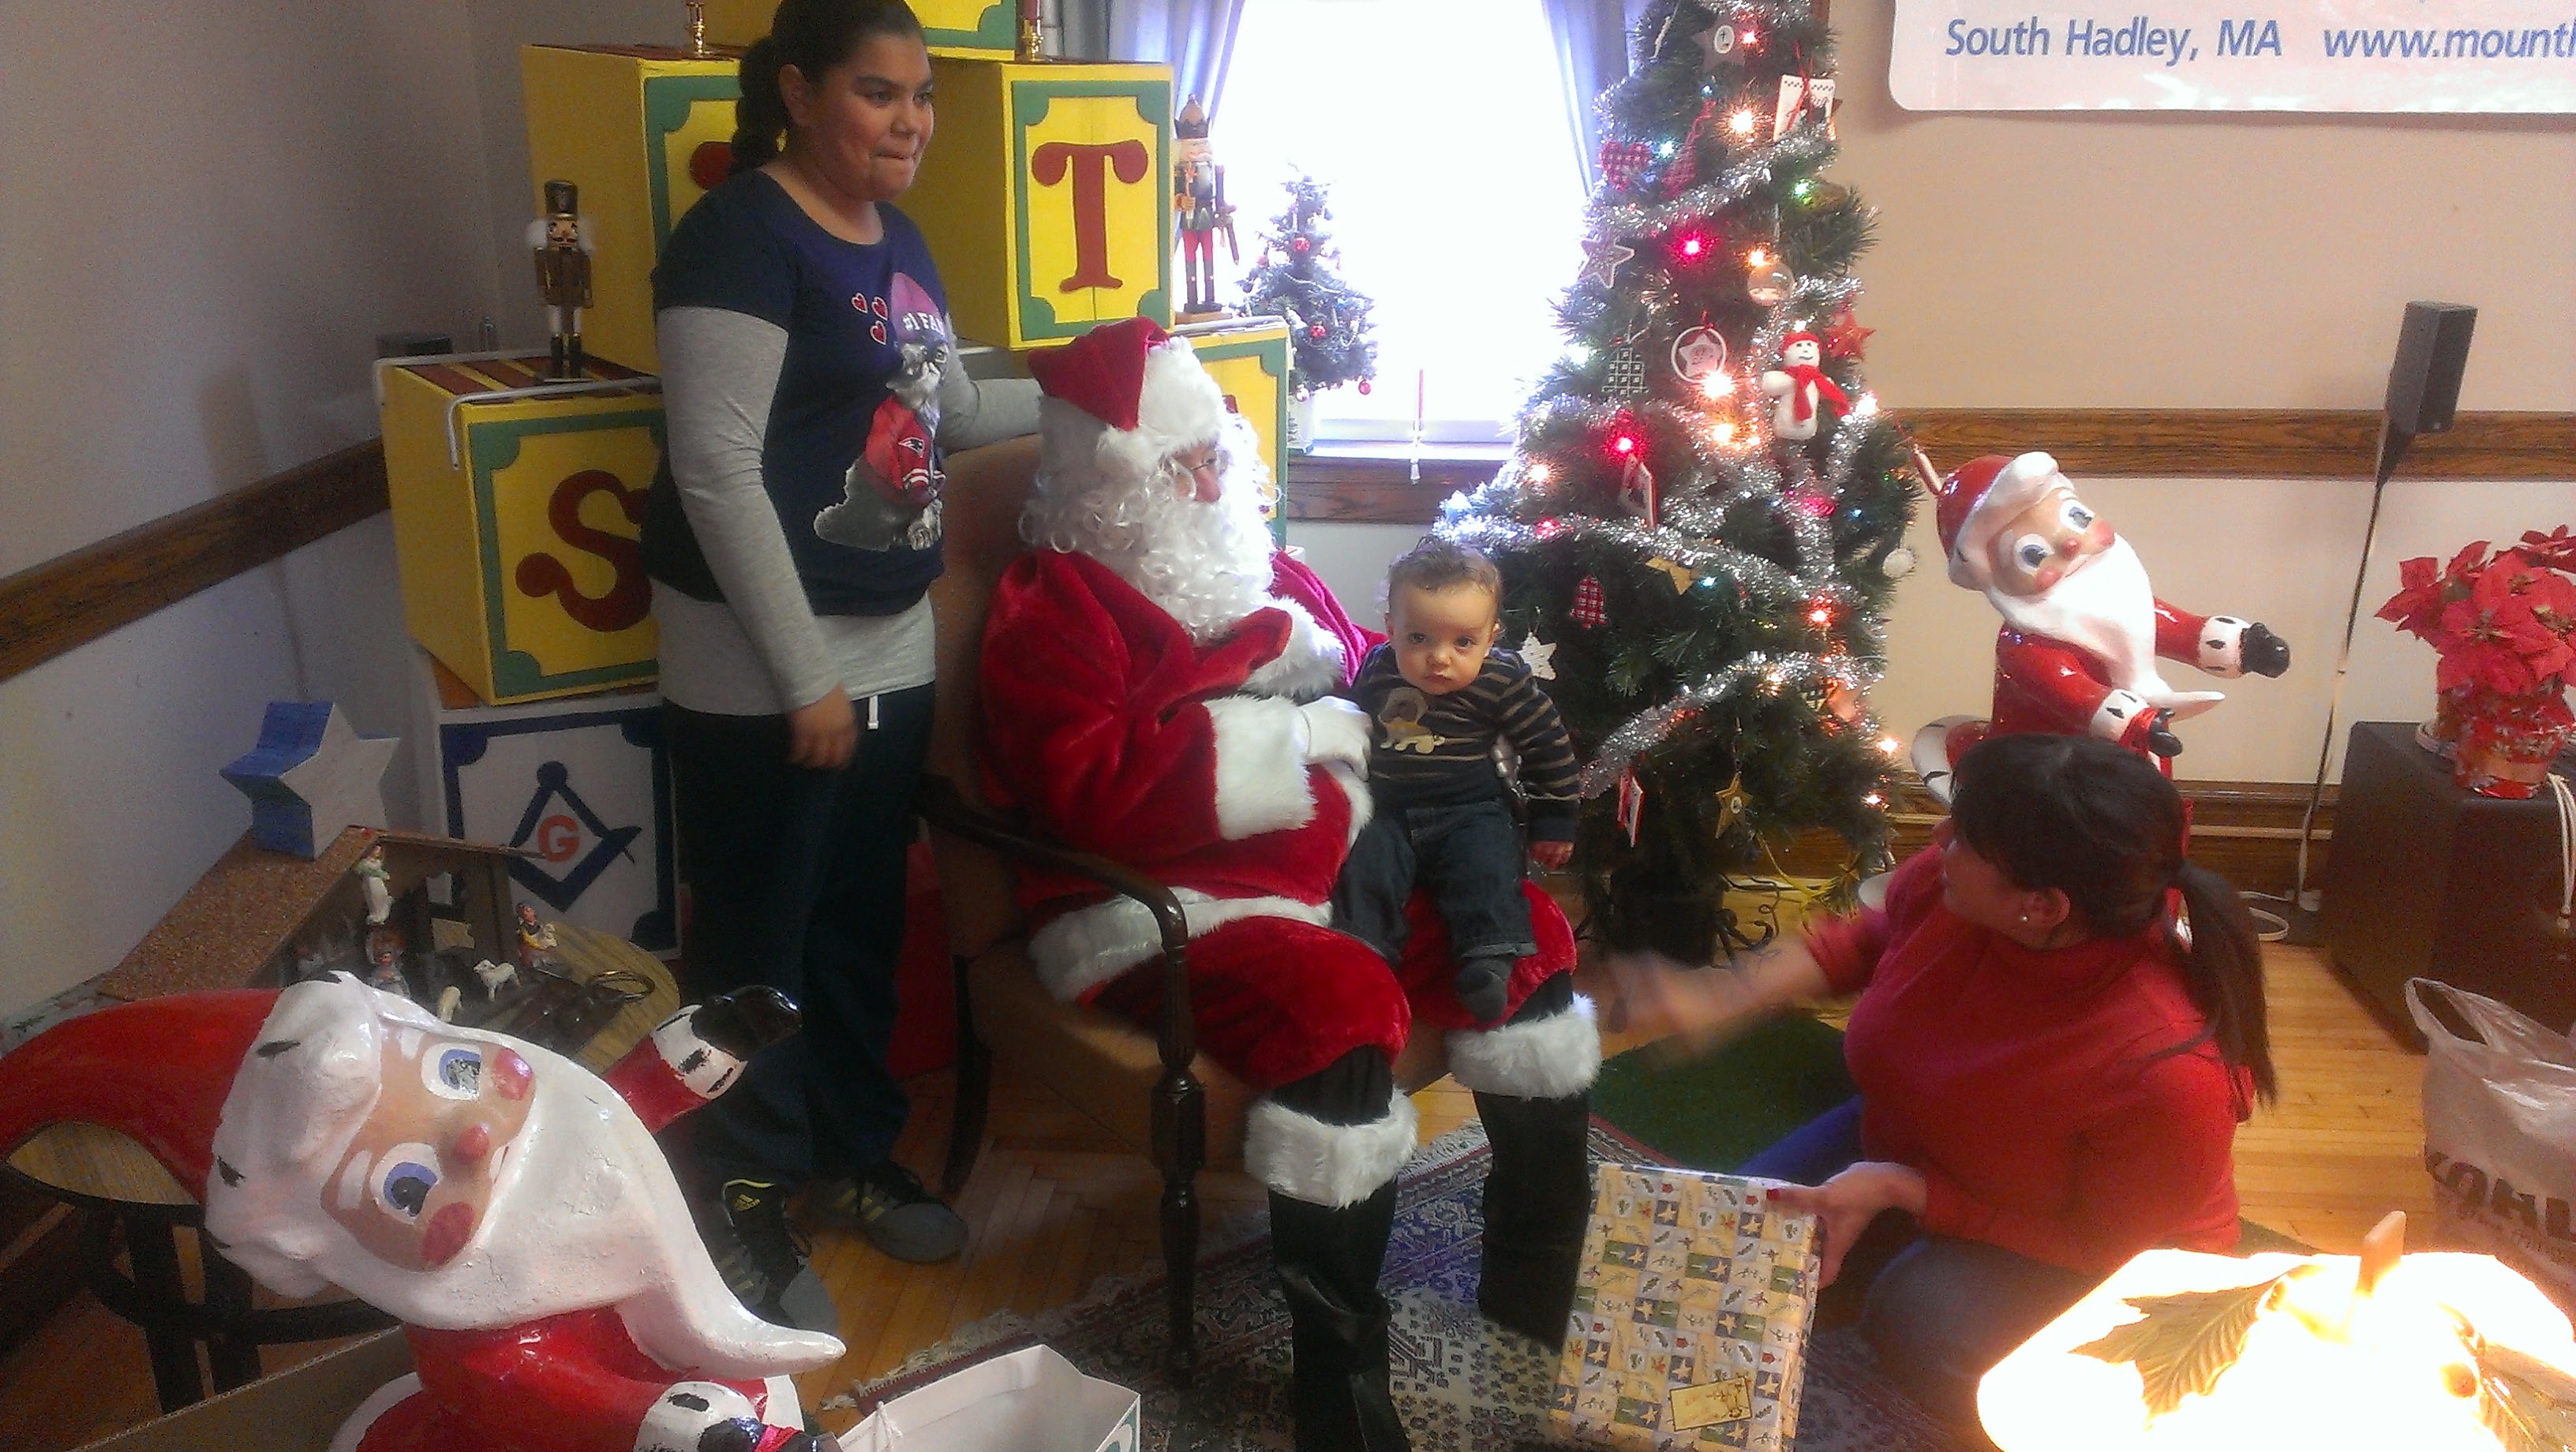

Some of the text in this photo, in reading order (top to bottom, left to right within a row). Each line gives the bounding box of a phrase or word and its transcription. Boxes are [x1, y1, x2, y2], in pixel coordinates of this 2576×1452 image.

[1945, 16, 2051, 57] South
[2065, 15, 2199, 68] Hadley,
[2216, 18, 2282, 57] MA
[1032, 139, 1149, 293] T
[515, 470, 653, 632] S
[537, 814, 580, 863] G
